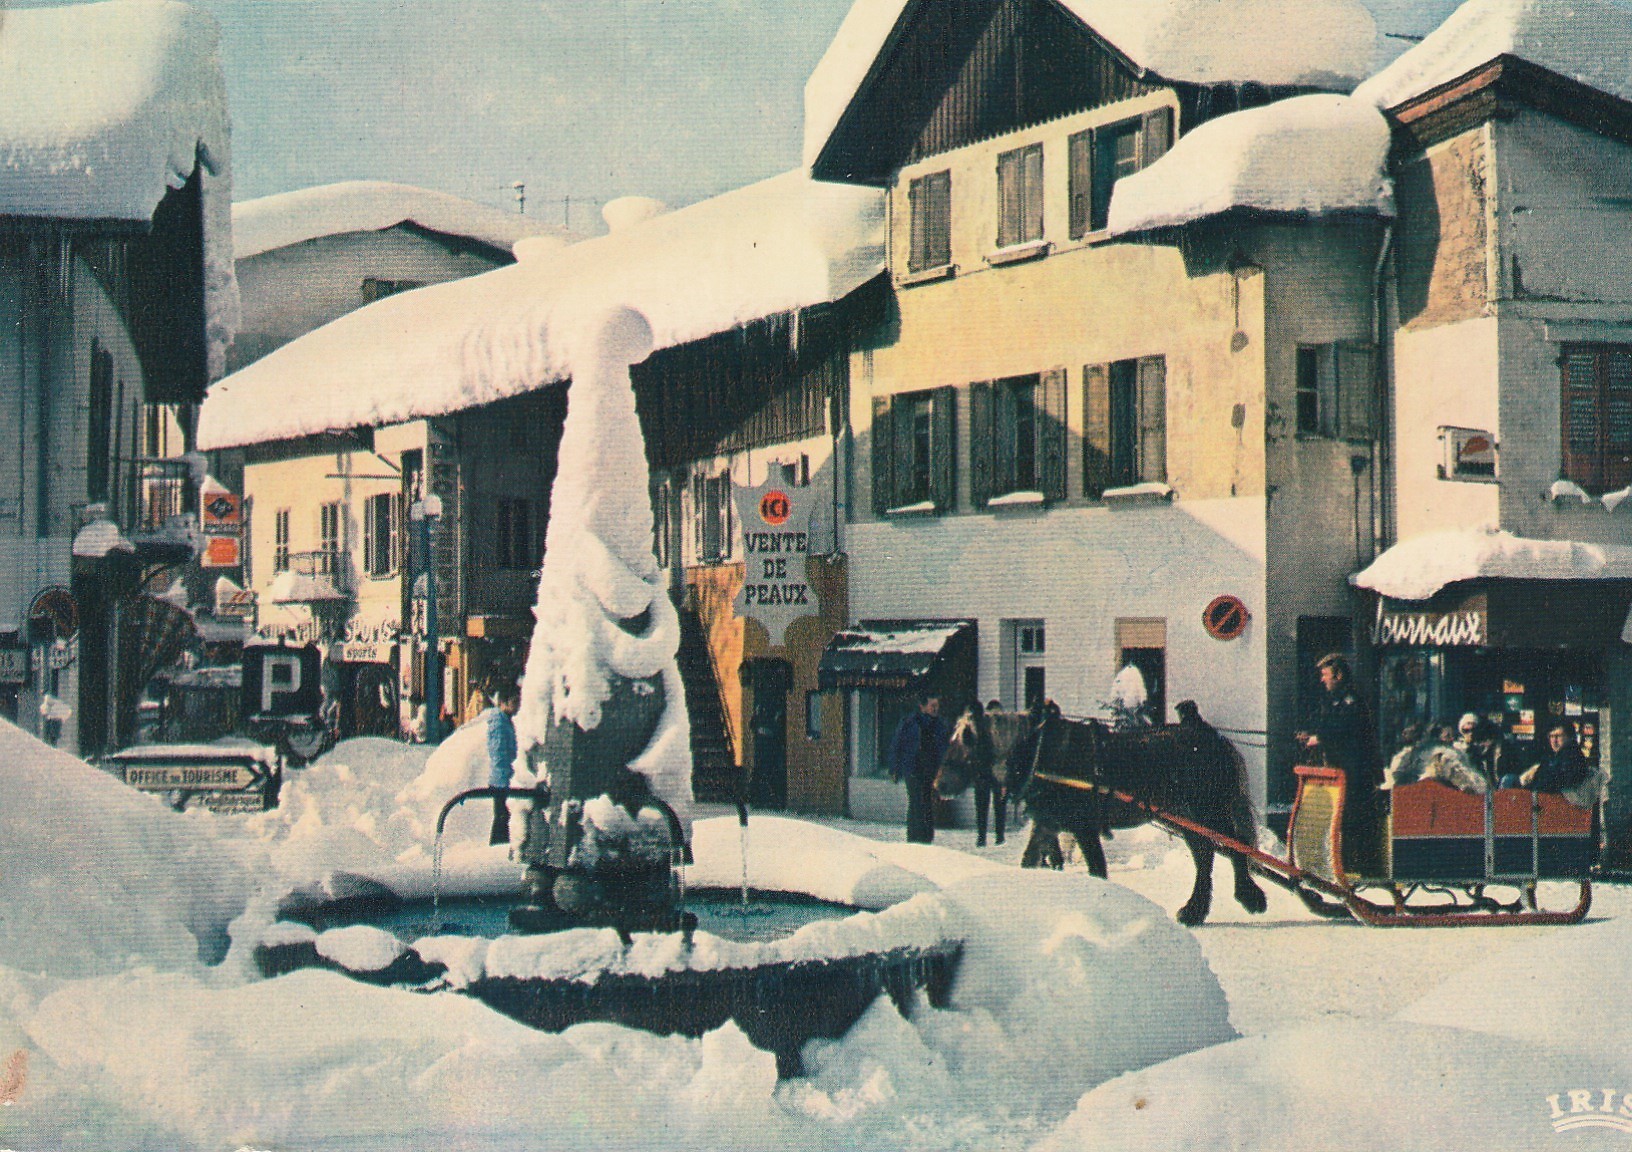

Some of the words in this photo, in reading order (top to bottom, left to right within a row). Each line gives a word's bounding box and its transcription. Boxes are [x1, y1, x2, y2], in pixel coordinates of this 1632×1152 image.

[761, 498, 789, 518] ICI
[744, 532, 807, 554] VENTE
[763, 558, 787, 580] DE
[744, 584, 809, 606] PEAUX
[1369, 597, 1482, 646] Journaux
[261, 655, 301, 712] P
[130, 769, 168, 784] OFFICE
[183, 768, 238, 784] TOURISME
